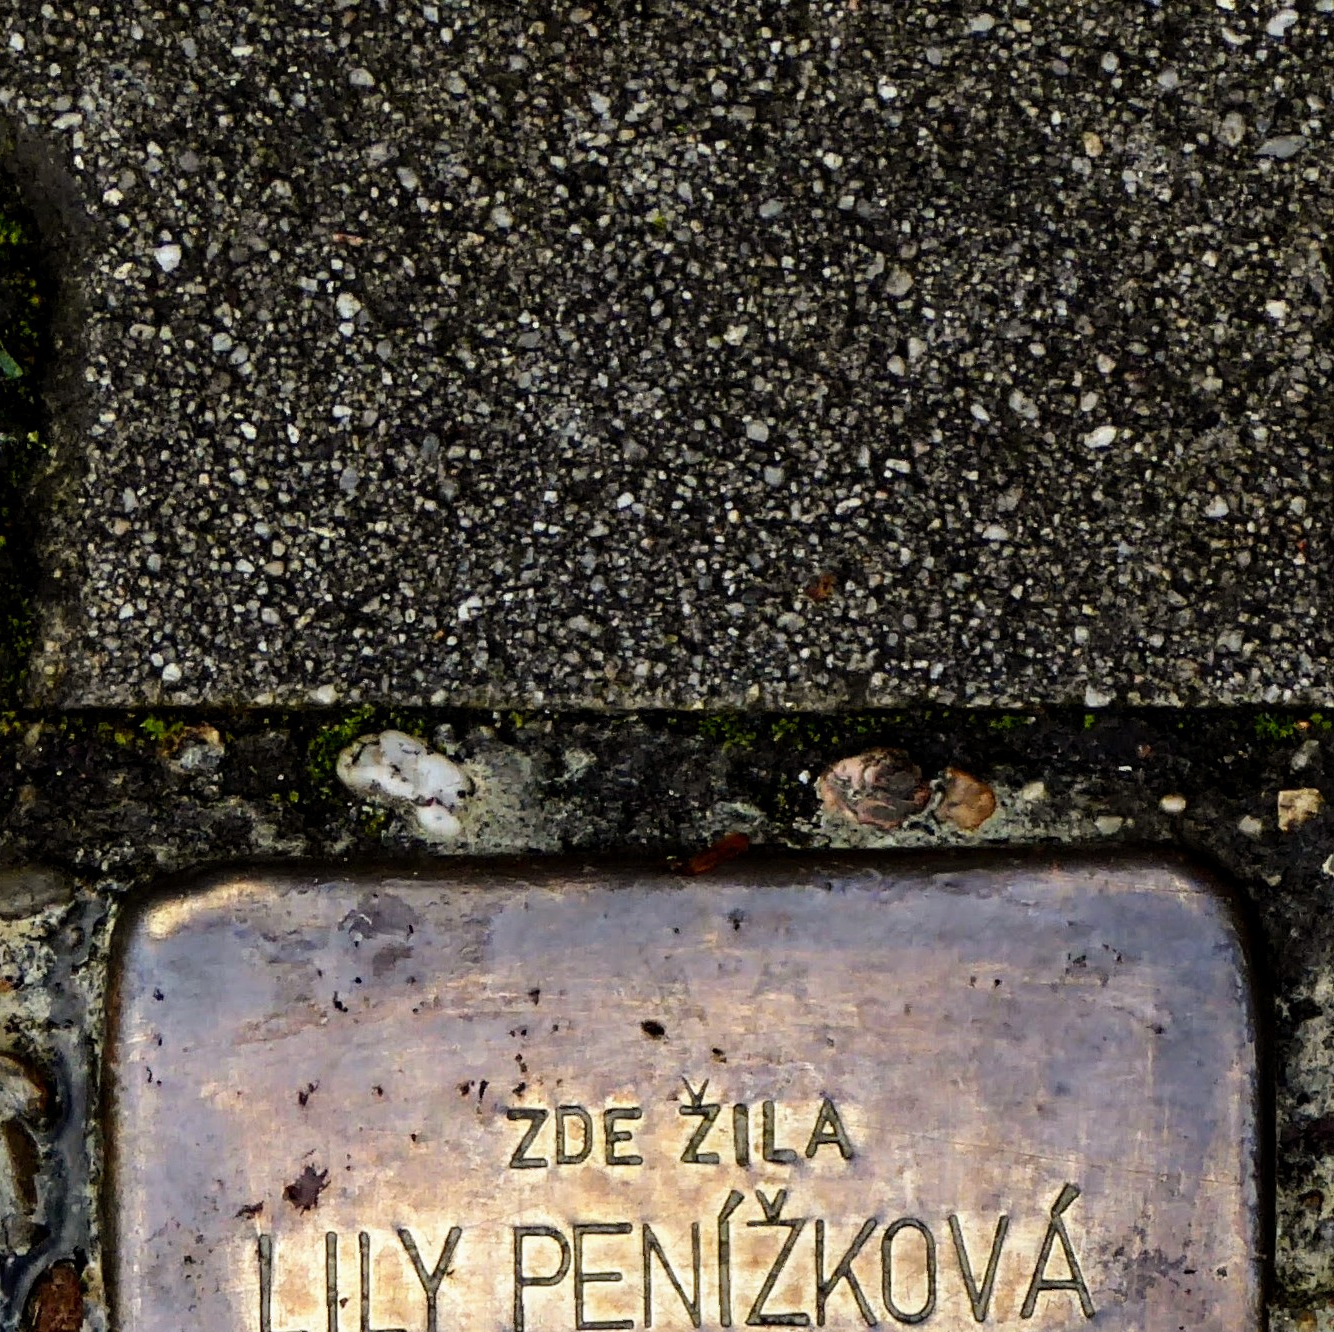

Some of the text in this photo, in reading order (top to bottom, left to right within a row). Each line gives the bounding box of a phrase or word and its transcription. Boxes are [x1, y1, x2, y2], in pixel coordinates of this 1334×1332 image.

[505, 1078, 856, 1170] ZDE ŽILA
[512, 1182, 1098, 1332] PENÍŽKOVÁ
